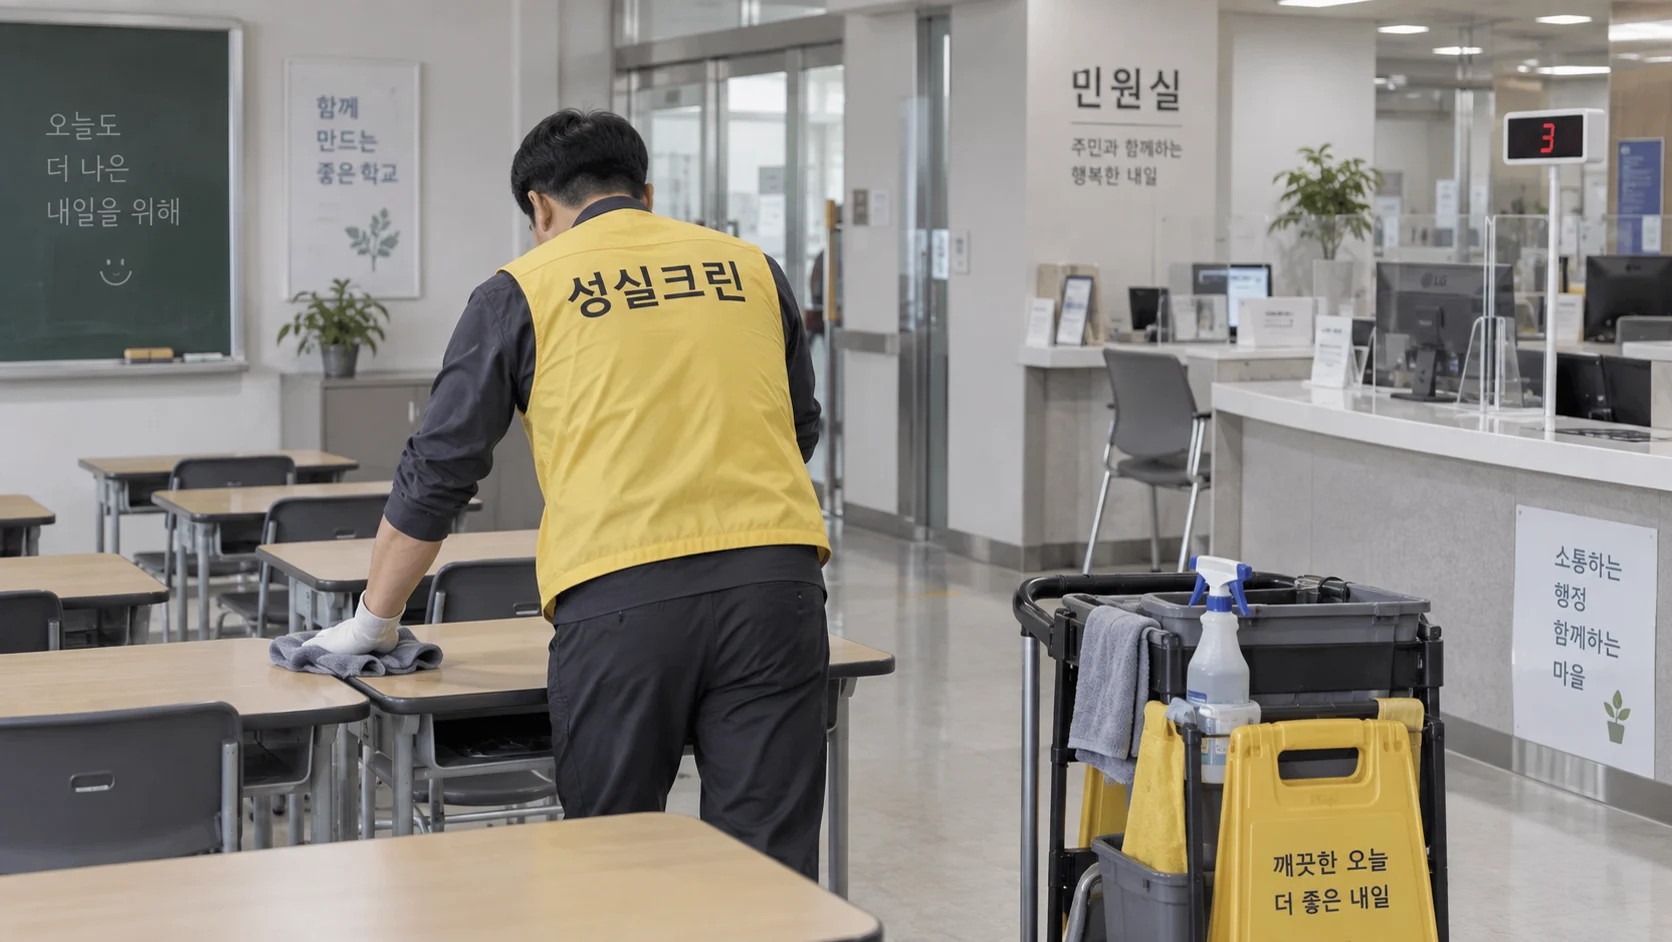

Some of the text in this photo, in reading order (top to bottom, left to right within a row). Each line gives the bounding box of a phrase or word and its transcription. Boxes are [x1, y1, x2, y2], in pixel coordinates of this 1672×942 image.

[1072, 66, 1179, 112] 민원실
[316, 95, 358, 120] 함께
[45, 111, 121, 141] 오늘도
[316, 128, 378, 154] 만드는
[1540, 123, 1555, 153] 3
[1071, 138, 1182, 159] 주민과 함께하는
[48, 154, 130, 183] 더 나은
[316, 161, 398, 186] 좋은 학교
[1071, 165, 1157, 187] 행복한 내일
[47, 196, 180, 228] 내일을 위해
[567, 260, 747, 318] 성실크린
[1554, 545, 1623, 582] 소통하는
[1554, 582, 1586, 613] 행정
[1553, 619, 1621, 659] 함께하는
[1553, 660, 1586, 691] 마을
[1273, 847, 1389, 878] 깨끗한 오늘
[1274, 884, 1390, 916] 더 좋은 내일
